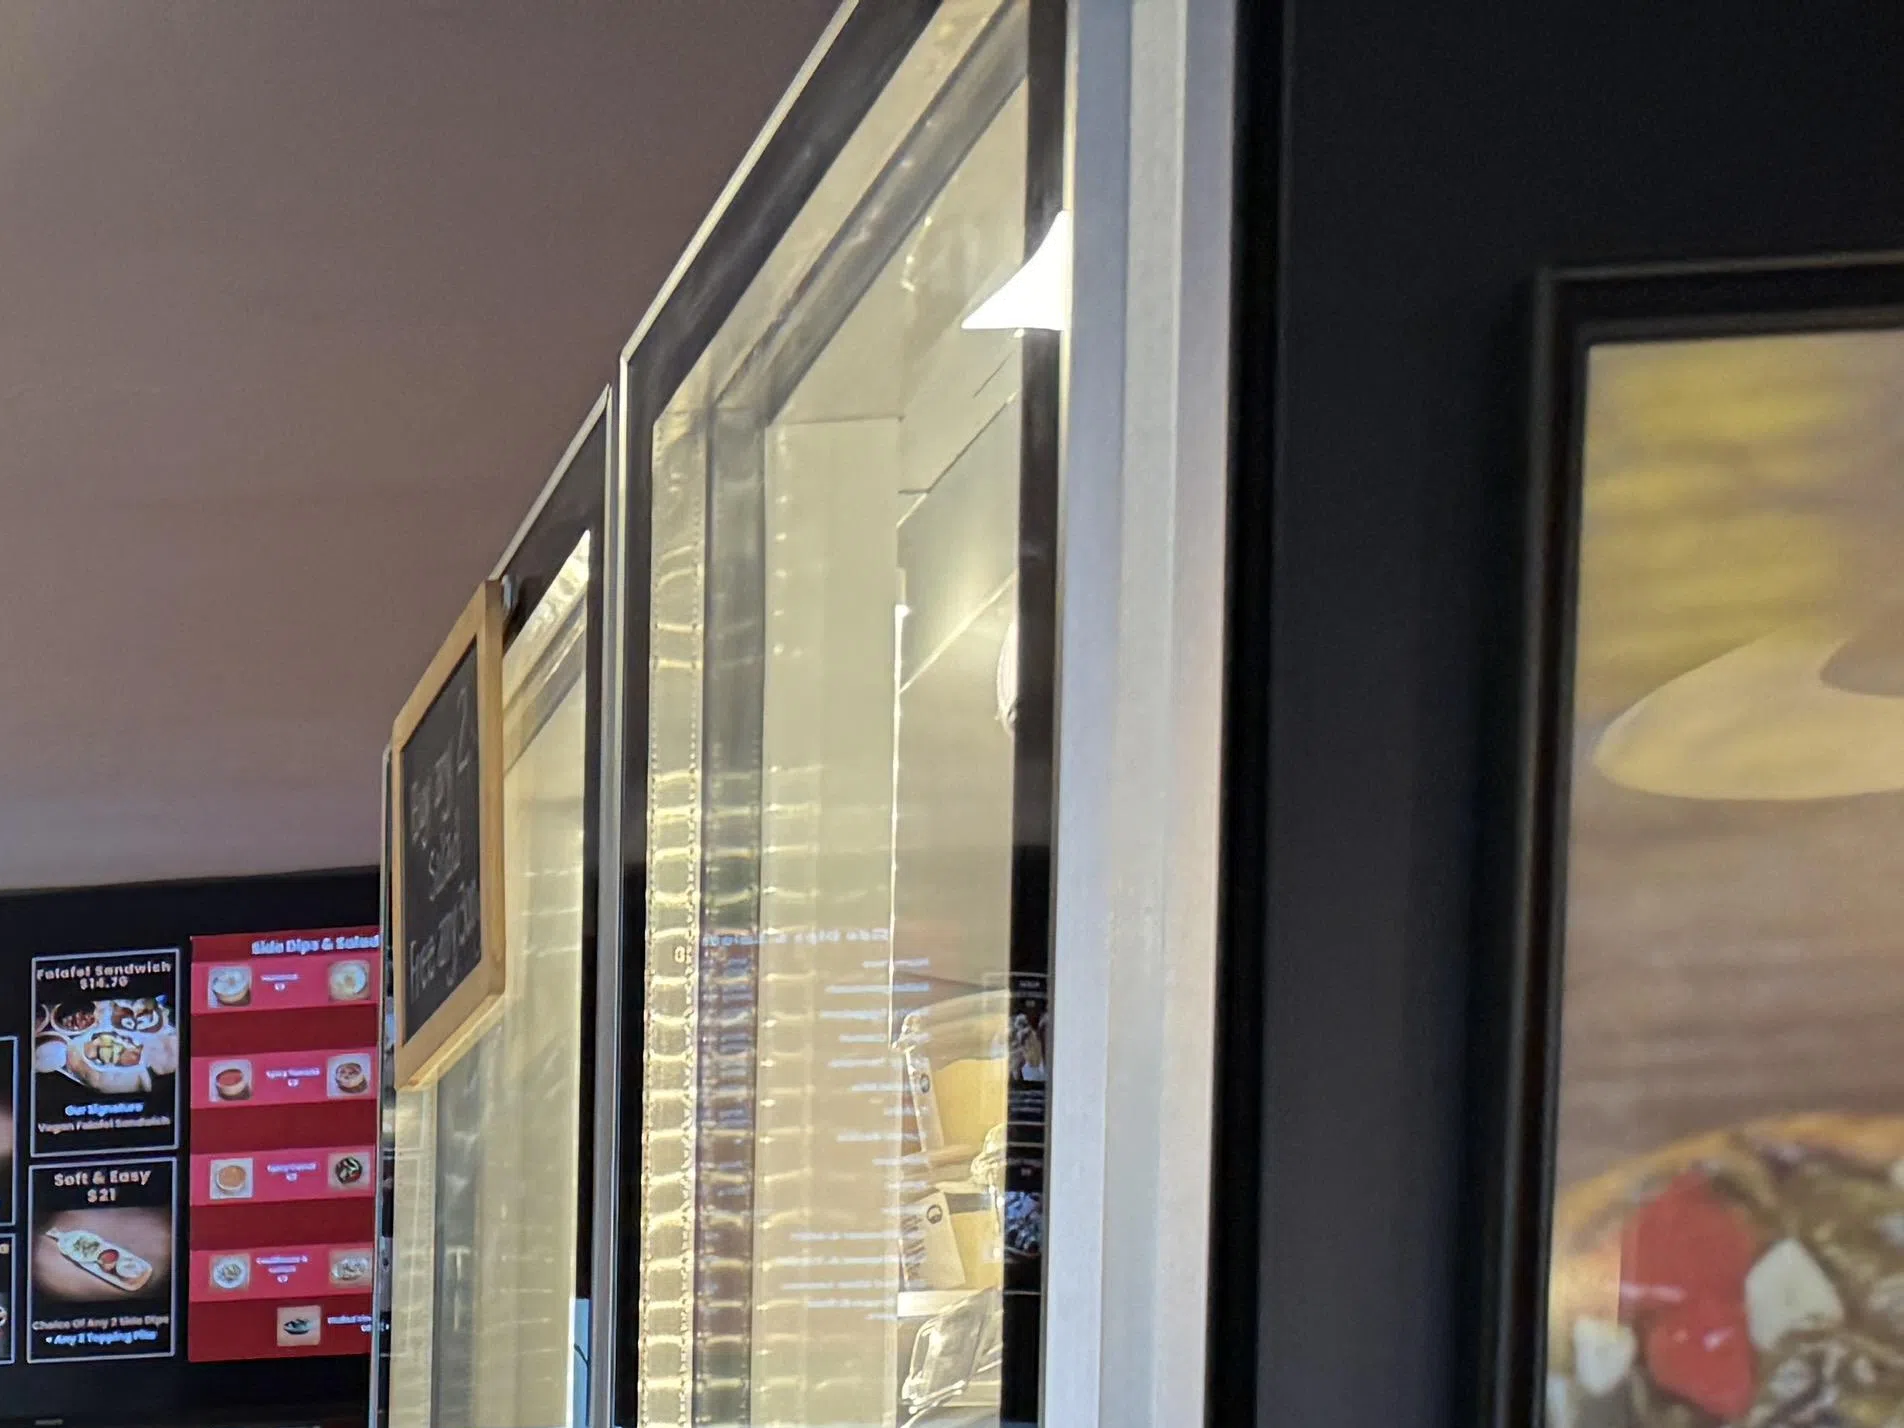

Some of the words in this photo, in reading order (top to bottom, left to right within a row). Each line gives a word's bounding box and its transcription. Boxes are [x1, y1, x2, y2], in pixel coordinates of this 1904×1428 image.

[37, 965, 90, 980] Falafel
[94, 961, 172, 976] Sandwich
[54, 1171, 88, 1187] Soft
[110, 1169, 152, 1186] Easy
[87, 1188, 116, 1203] $21
